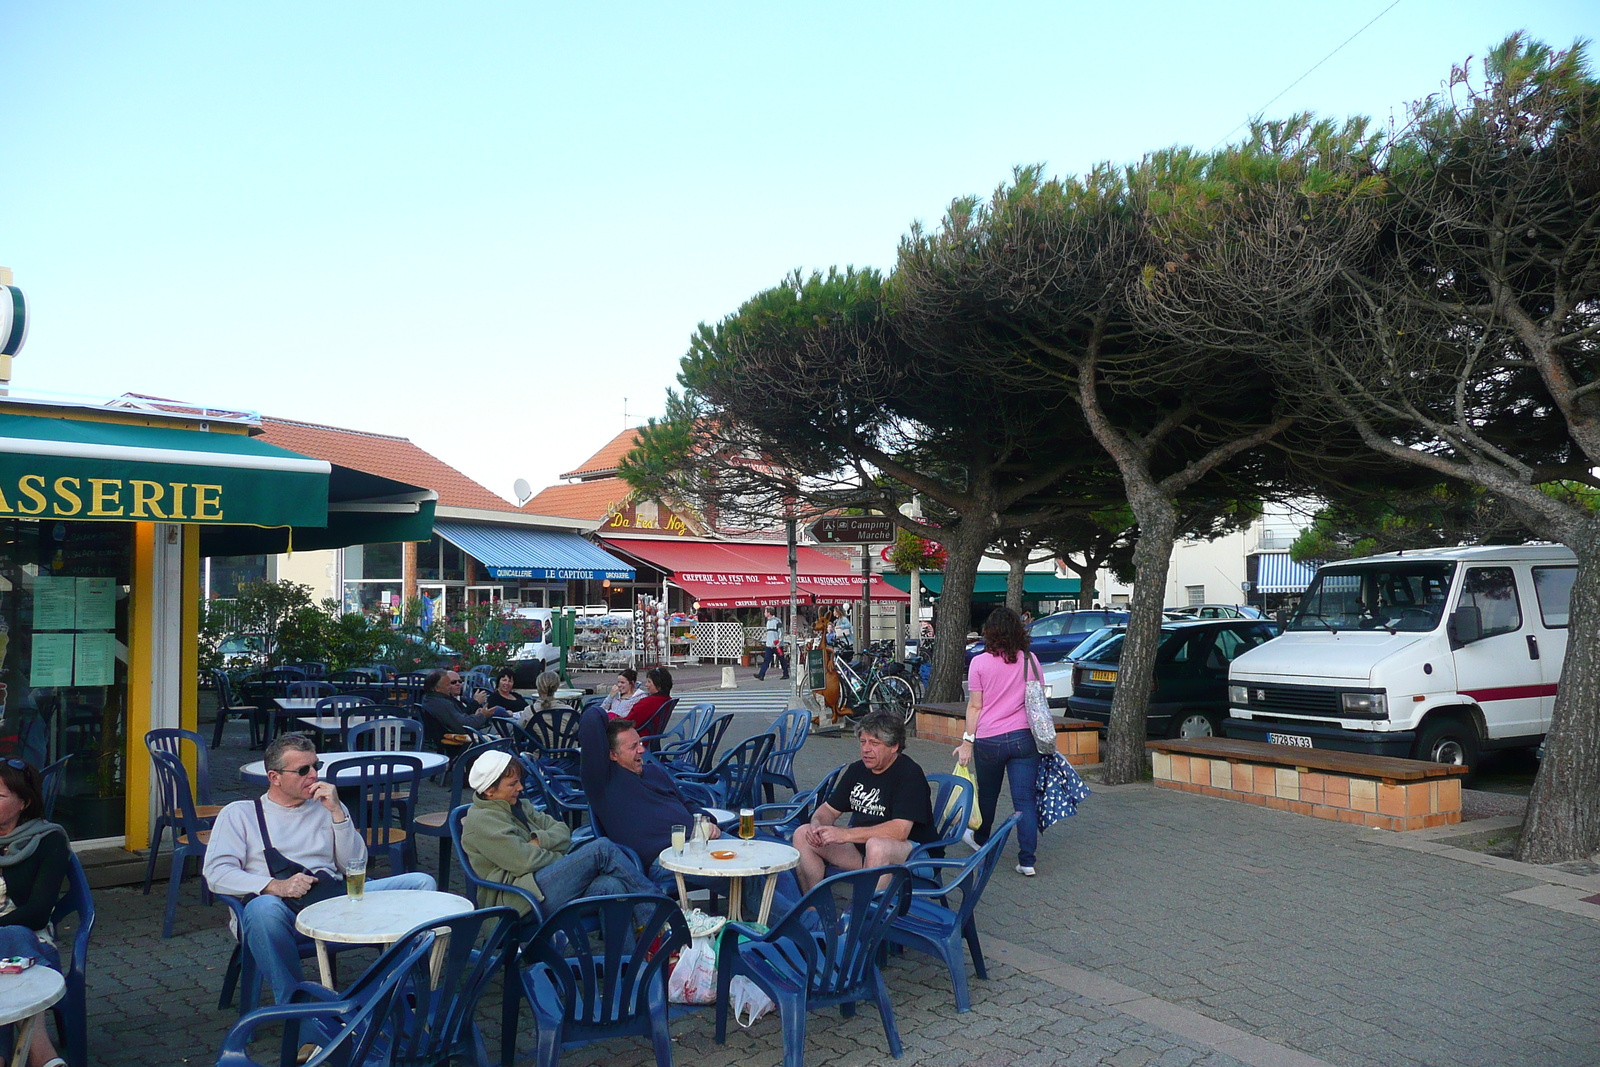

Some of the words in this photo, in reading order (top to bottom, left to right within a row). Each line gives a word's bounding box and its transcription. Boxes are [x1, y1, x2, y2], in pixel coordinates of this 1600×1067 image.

[610, 512, 630, 528] Da
[663, 513, 687, 536] Noz
[850, 520, 890, 530] Camping
[857, 531, 890, 539] Marché
[545, 569, 556, 578] LE
[558, 570, 594, 579] CAPITOLE
[682, 573, 715, 582] CREPERIE
[717, 574, 727, 582] DA
[728, 574, 744, 583] FEST
[745, 575, 760, 583] NOZ
[1300, 738, 1311, 748] 33
